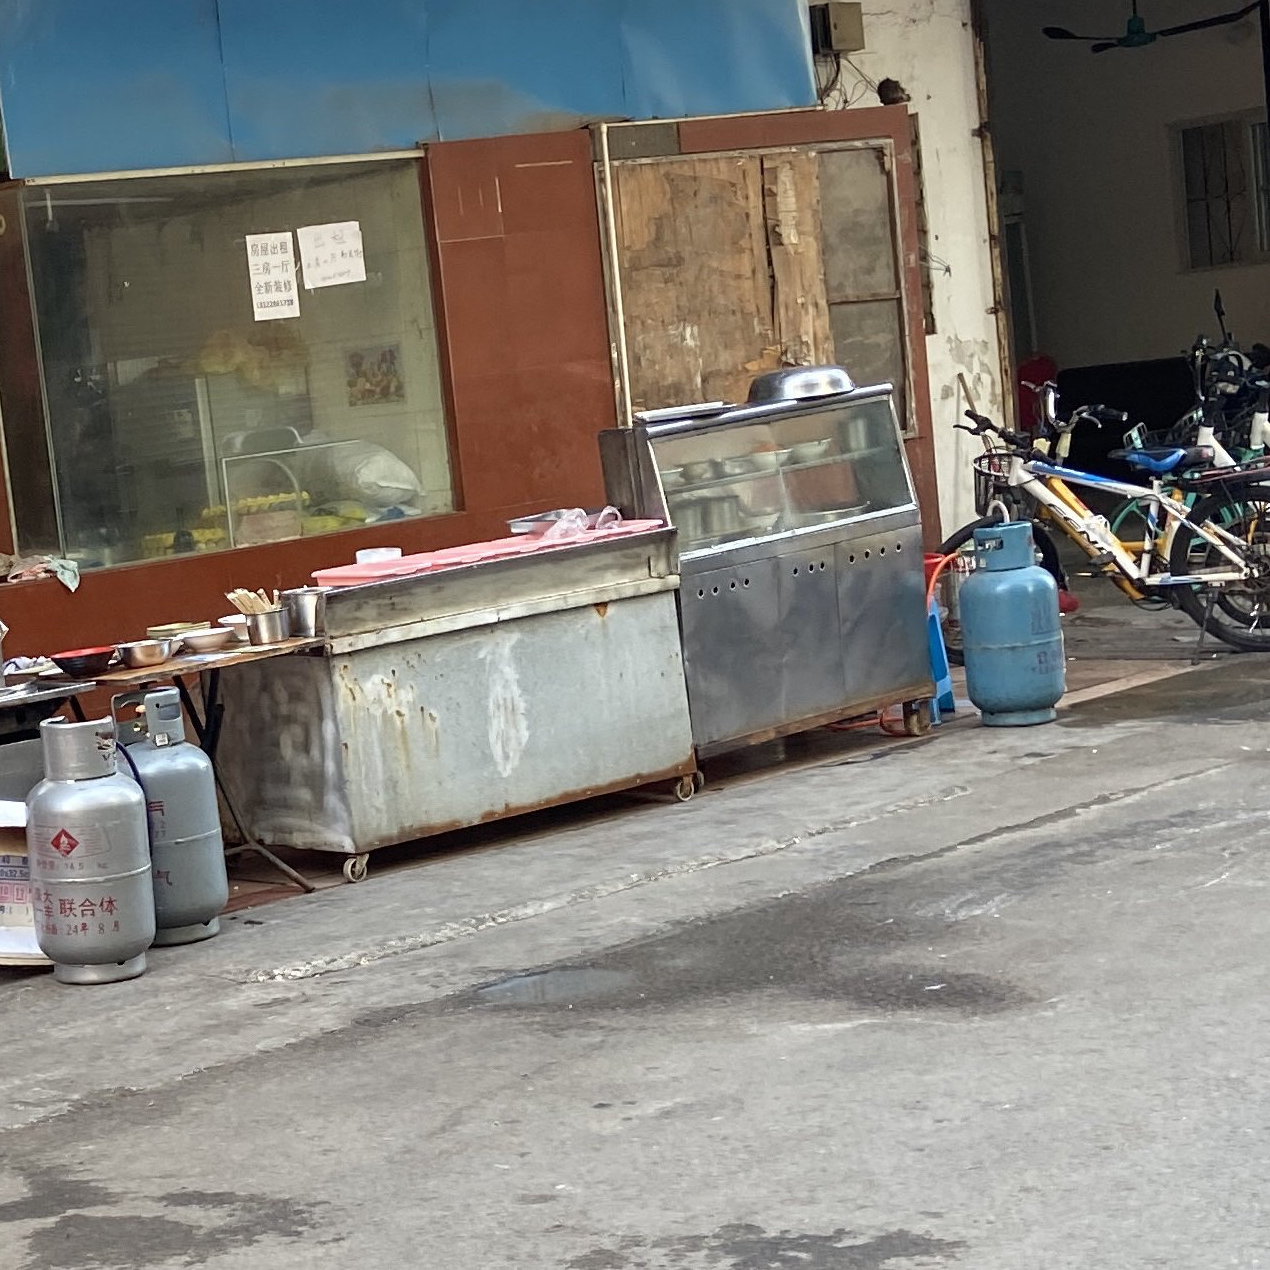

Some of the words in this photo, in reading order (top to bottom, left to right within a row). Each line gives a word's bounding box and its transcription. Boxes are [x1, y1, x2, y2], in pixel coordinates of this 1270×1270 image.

[251, 260, 291, 275] 三房一厅
[59, 896, 118, 918] 联合体
